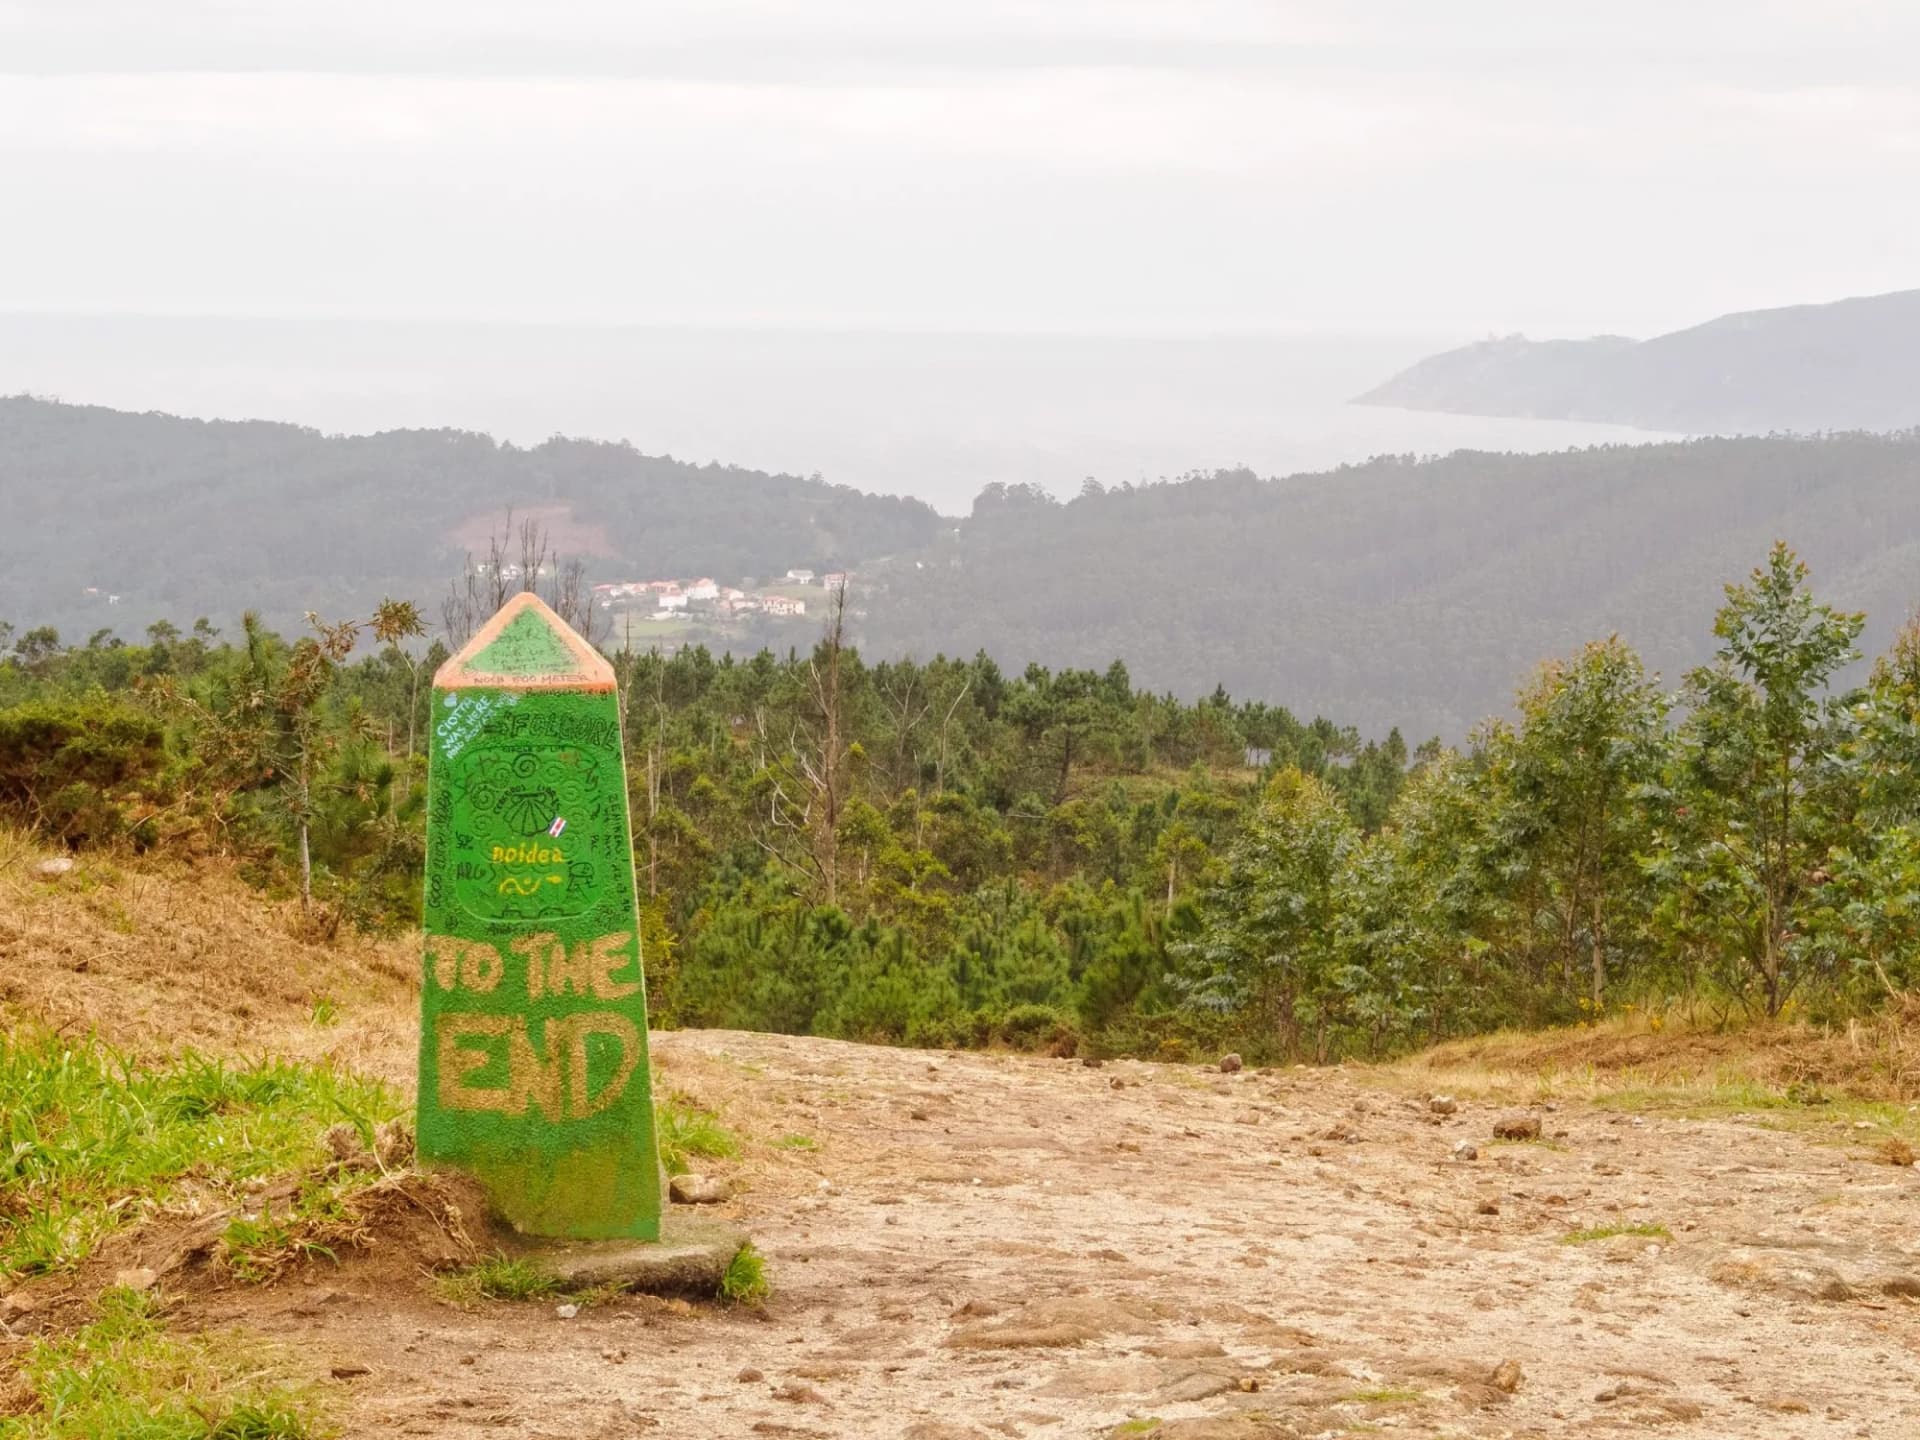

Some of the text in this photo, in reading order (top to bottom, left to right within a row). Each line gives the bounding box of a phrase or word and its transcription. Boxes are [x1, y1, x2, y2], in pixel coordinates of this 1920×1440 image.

[426, 930, 640, 1001] TO THE
[436, 1012, 640, 1122] END
